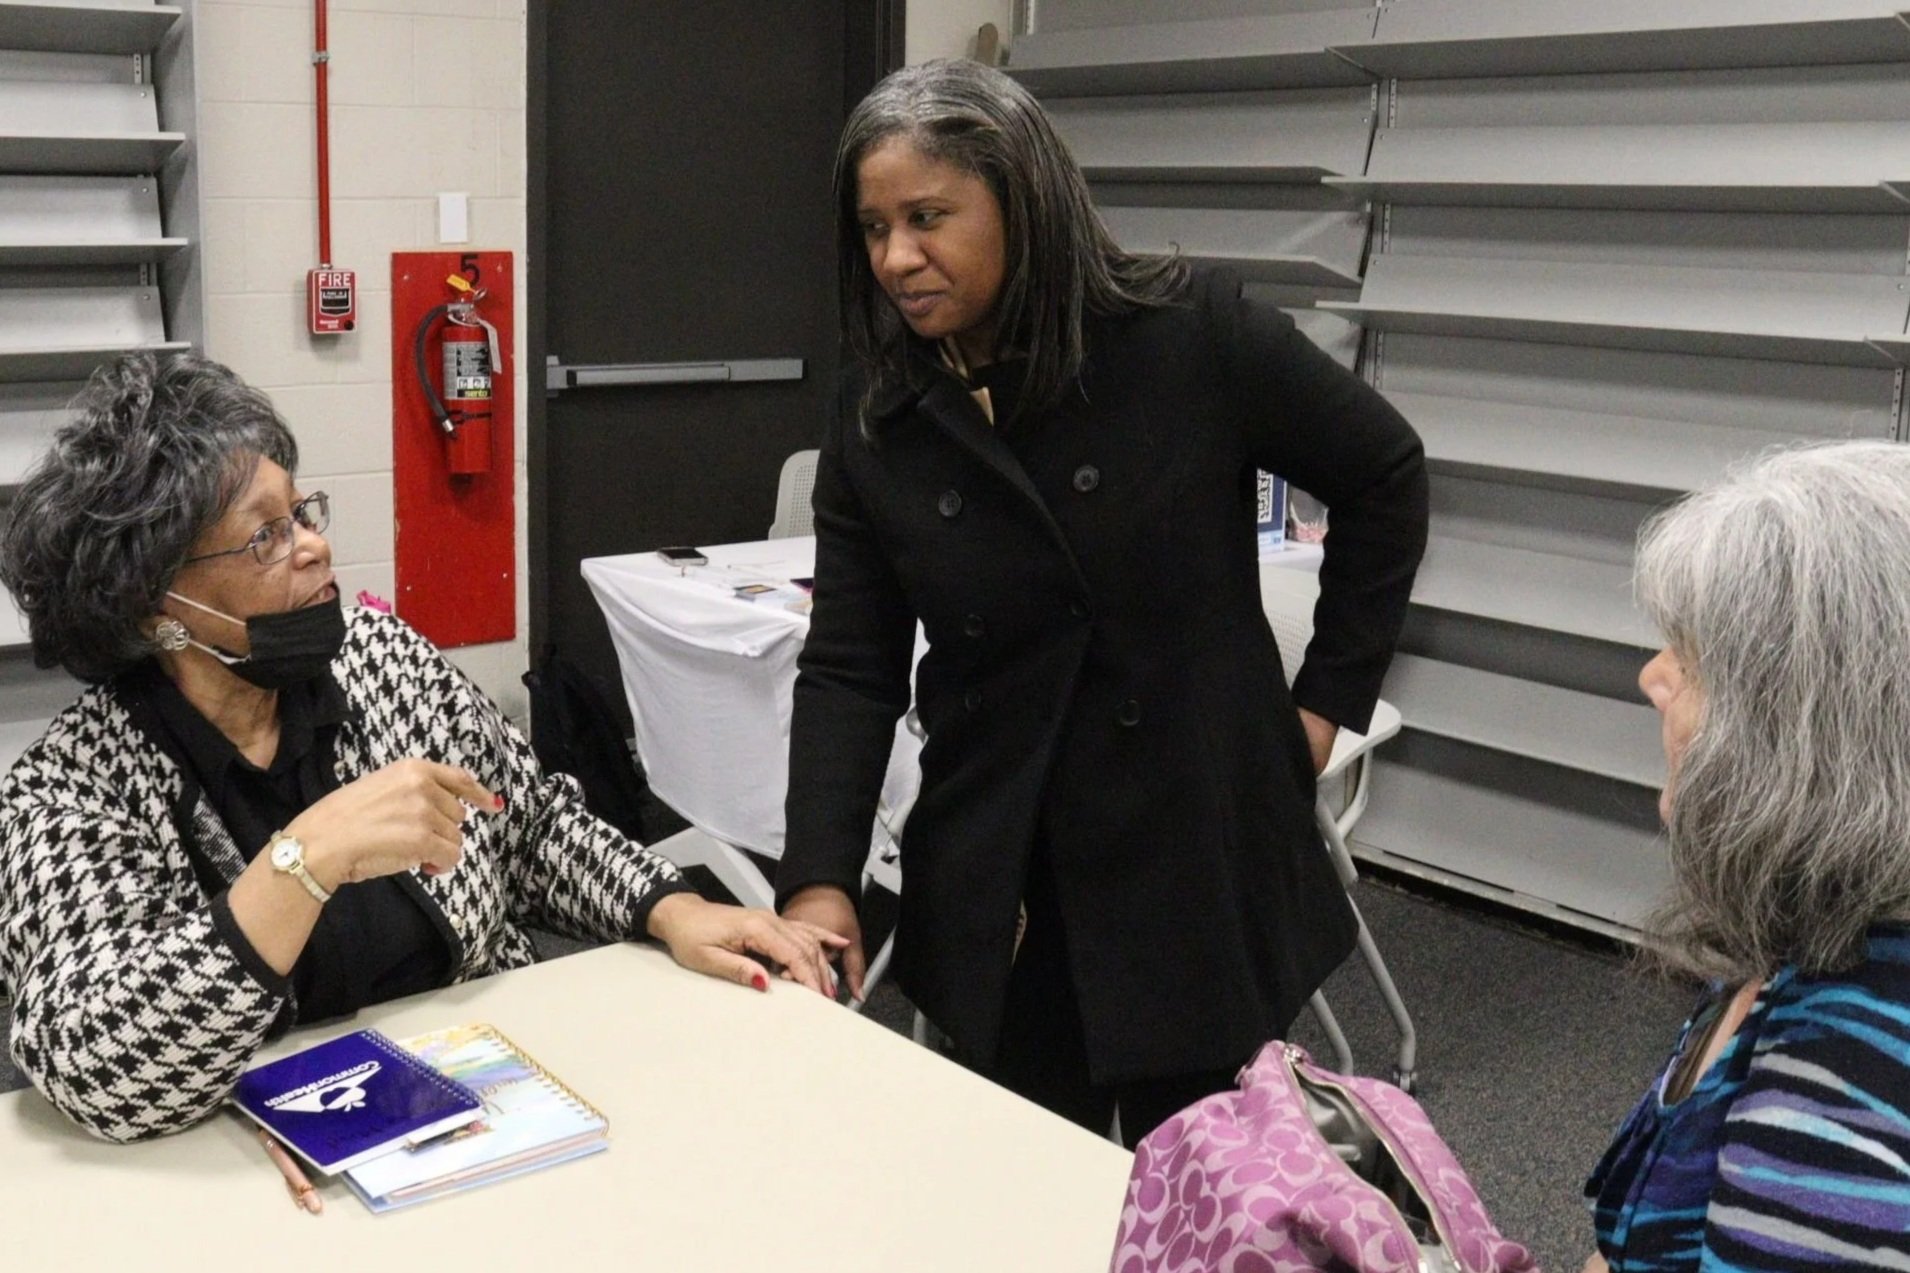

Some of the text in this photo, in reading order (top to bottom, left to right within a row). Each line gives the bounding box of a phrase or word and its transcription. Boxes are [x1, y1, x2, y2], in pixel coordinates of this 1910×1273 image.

[319, 273, 351, 287] FIRE
[461, 253, 480, 288] 5
[264, 1060, 380, 1108] CommonHealth
